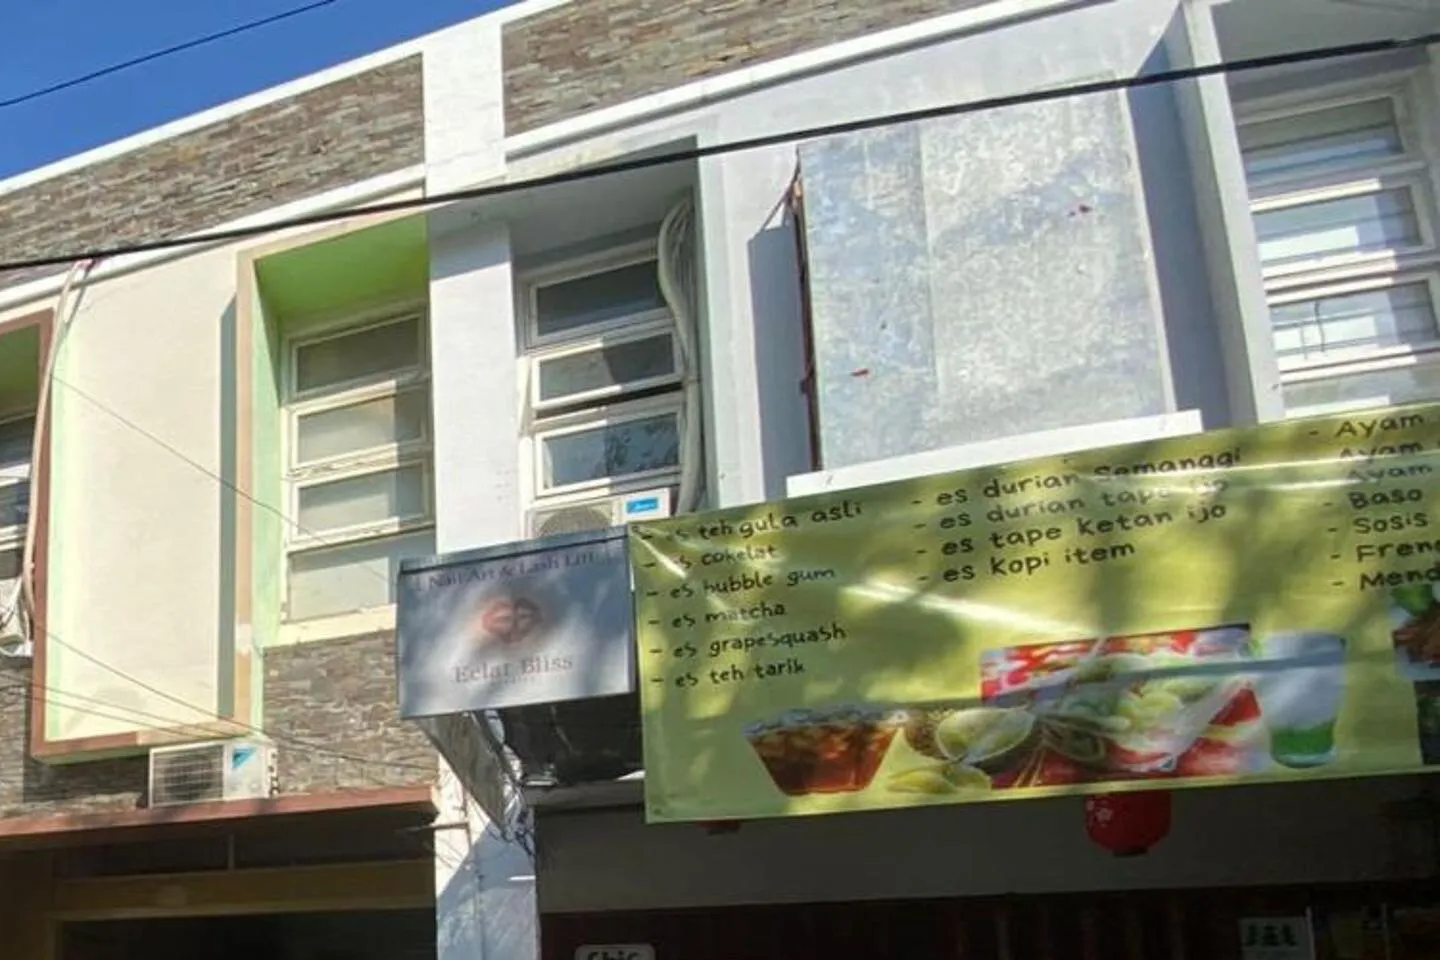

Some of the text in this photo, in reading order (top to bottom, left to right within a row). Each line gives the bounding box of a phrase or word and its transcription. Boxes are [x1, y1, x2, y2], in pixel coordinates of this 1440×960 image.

[1334, 414, 1424, 438] Ayam
[936, 489, 969, 506] es
[983, 473, 1079, 499] durian
[1348, 488, 1422, 509] Baso
[698, 519, 733, 541] teh
[739, 513, 799, 538] gula
[811, 500, 864, 523] asli
[939, 512, 972, 530] es
[986, 498, 1085, 523] durian
[941, 537, 975, 556] es
[989, 526, 1062, 549] tape
[1186, 502, 1227, 524] ijo
[1353, 512, 1428, 534] Sosis
[942, 565, 976, 583] es
[1064, 542, 1136, 565] item
[670, 581, 694, 599] es
[786, 568, 836, 588] gum
[671, 602, 787, 629] es matcha
[672, 643, 698, 658] es
[675, 657, 806, 689] es teh tarik
